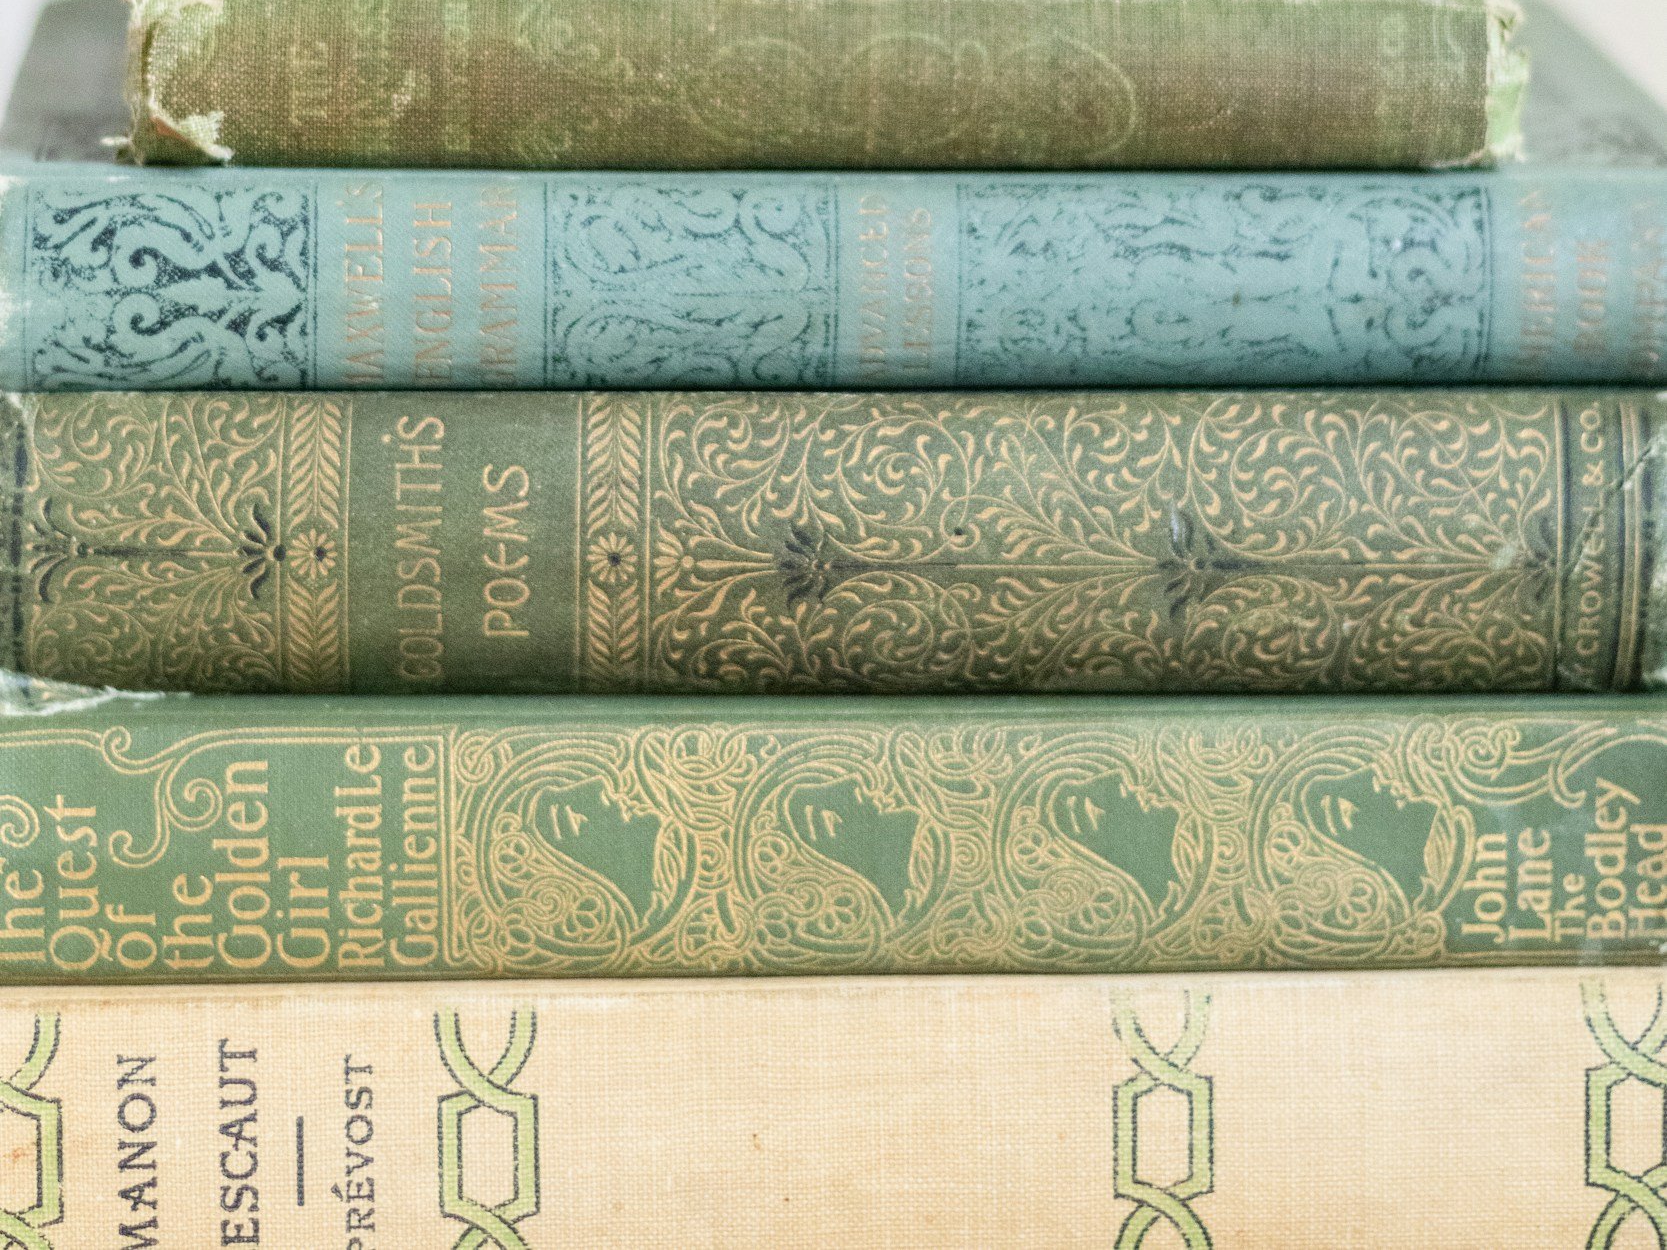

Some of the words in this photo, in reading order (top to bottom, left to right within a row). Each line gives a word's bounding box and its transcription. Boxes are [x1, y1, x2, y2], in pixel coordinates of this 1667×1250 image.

[412, 200, 453, 383] ENGLISH
[483, 463, 531, 638] POEMS
[44, 793, 113, 970] Quest
[163, 873, 215, 970] the
[213, 759, 271, 969] Golden
[275, 855, 331, 968] Girl
[333, 803, 386, 969] Richard
[388, 744, 440, 967] Gallienne
[1461, 832, 1507, 944] John
[1508, 826, 1553, 941] Lane
[1553, 872, 1587, 943] The
[1584, 777, 1641, 940] Bodley
[1627, 823, 1667, 938] Head
[218, 1037, 260, 1250] ESCAUT
